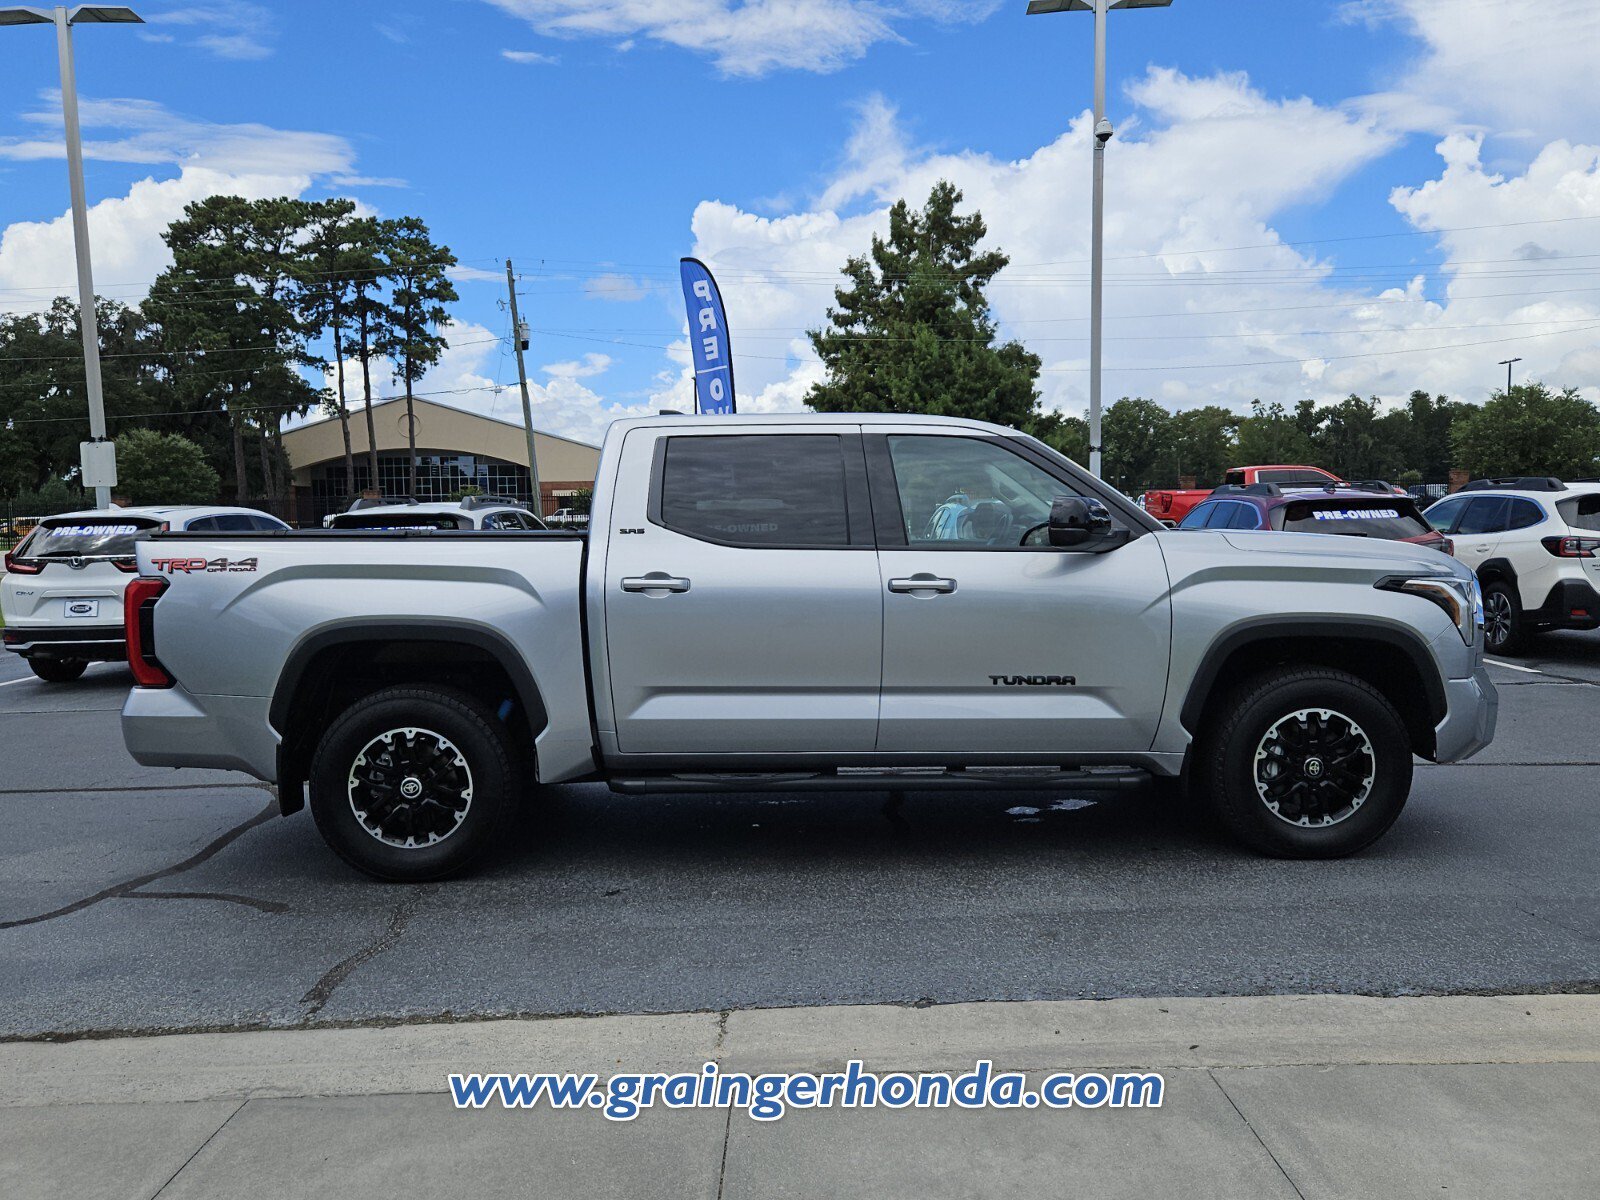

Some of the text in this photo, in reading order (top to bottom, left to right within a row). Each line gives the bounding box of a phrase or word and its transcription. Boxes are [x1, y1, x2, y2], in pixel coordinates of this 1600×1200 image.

[1313, 509, 1399, 521] PRE-OWNED
[52, 525, 137, 536] PRE-OWNED
[151, 558, 207, 574] TRD
[988, 675, 1076, 685] TUNDRA
